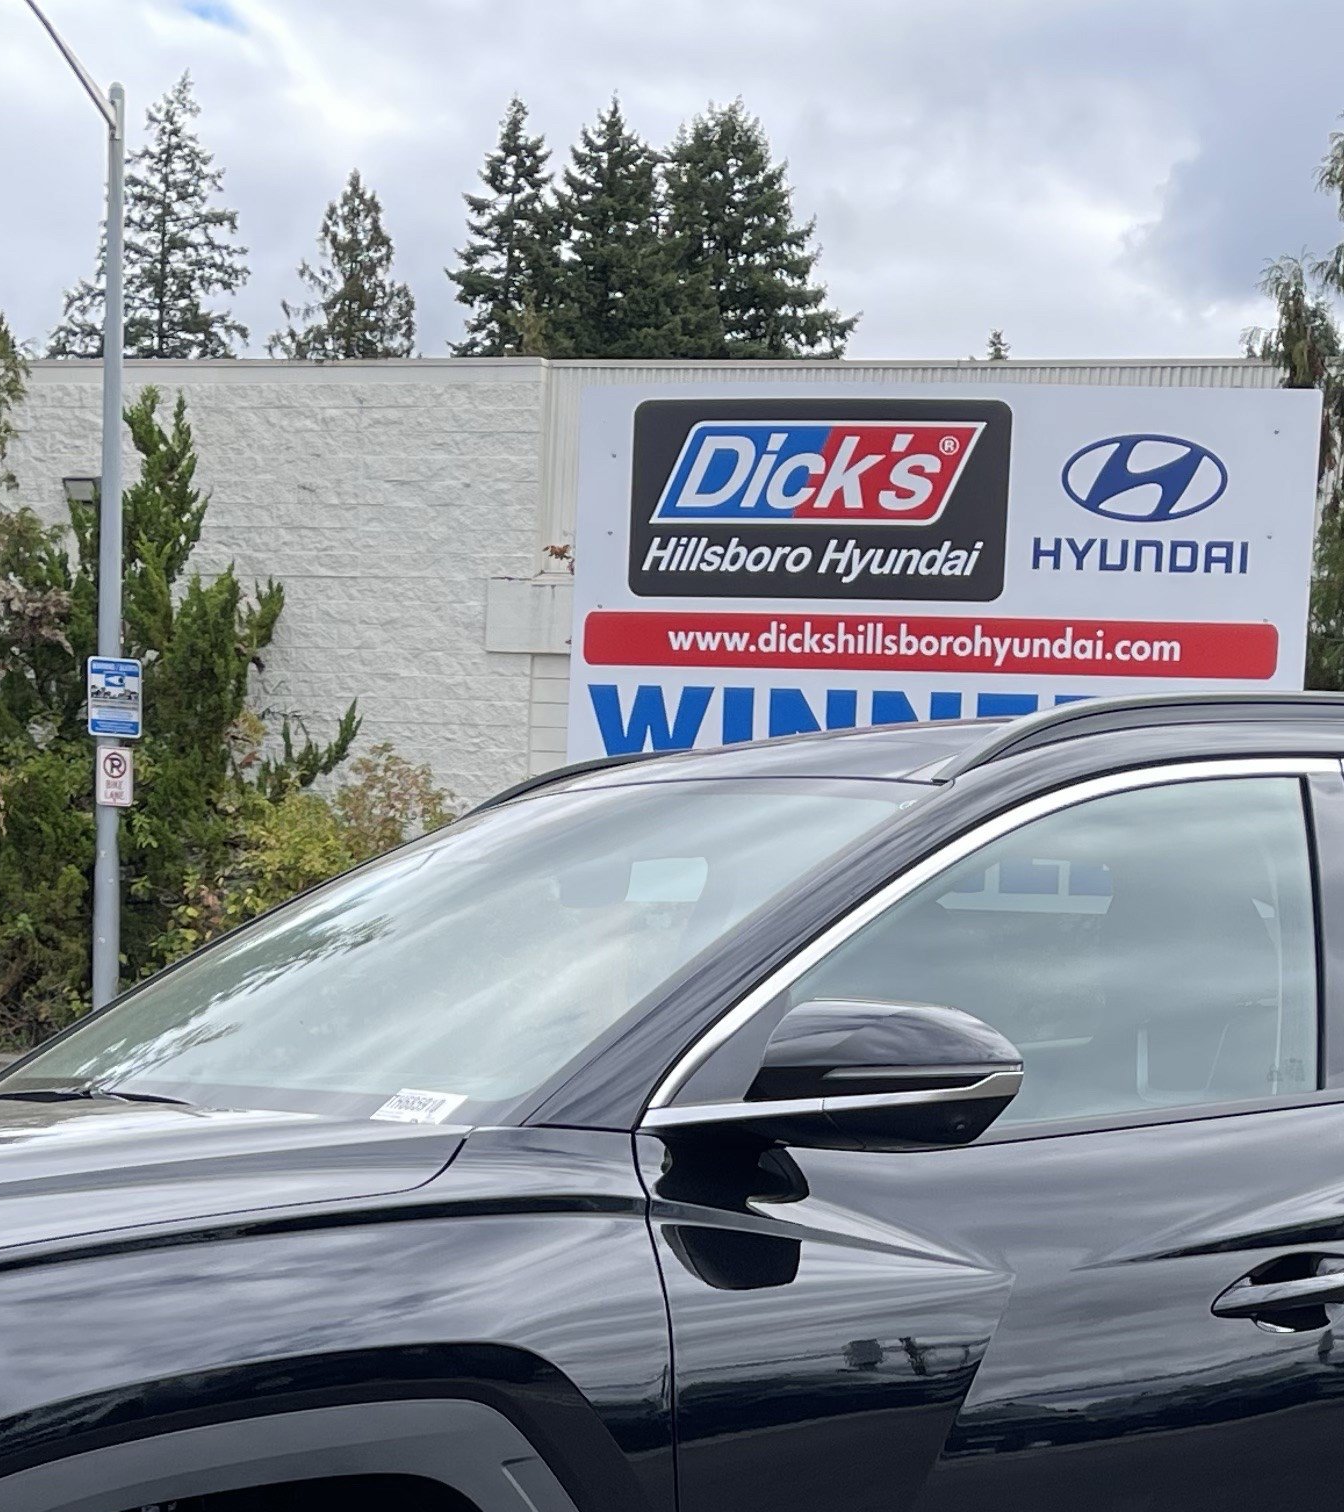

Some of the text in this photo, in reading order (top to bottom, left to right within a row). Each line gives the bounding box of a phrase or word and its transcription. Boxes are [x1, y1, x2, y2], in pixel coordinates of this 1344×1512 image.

[676, 433, 942, 510] Dick's
[642, 537, 984, 583] Hillsboro Hyundai
[1033, 538, 1248, 575] HYUNDAI
[668, 621, 1182, 667] www.dickshillsborohyundai.com
[587, 683, 1108, 762] WIN
